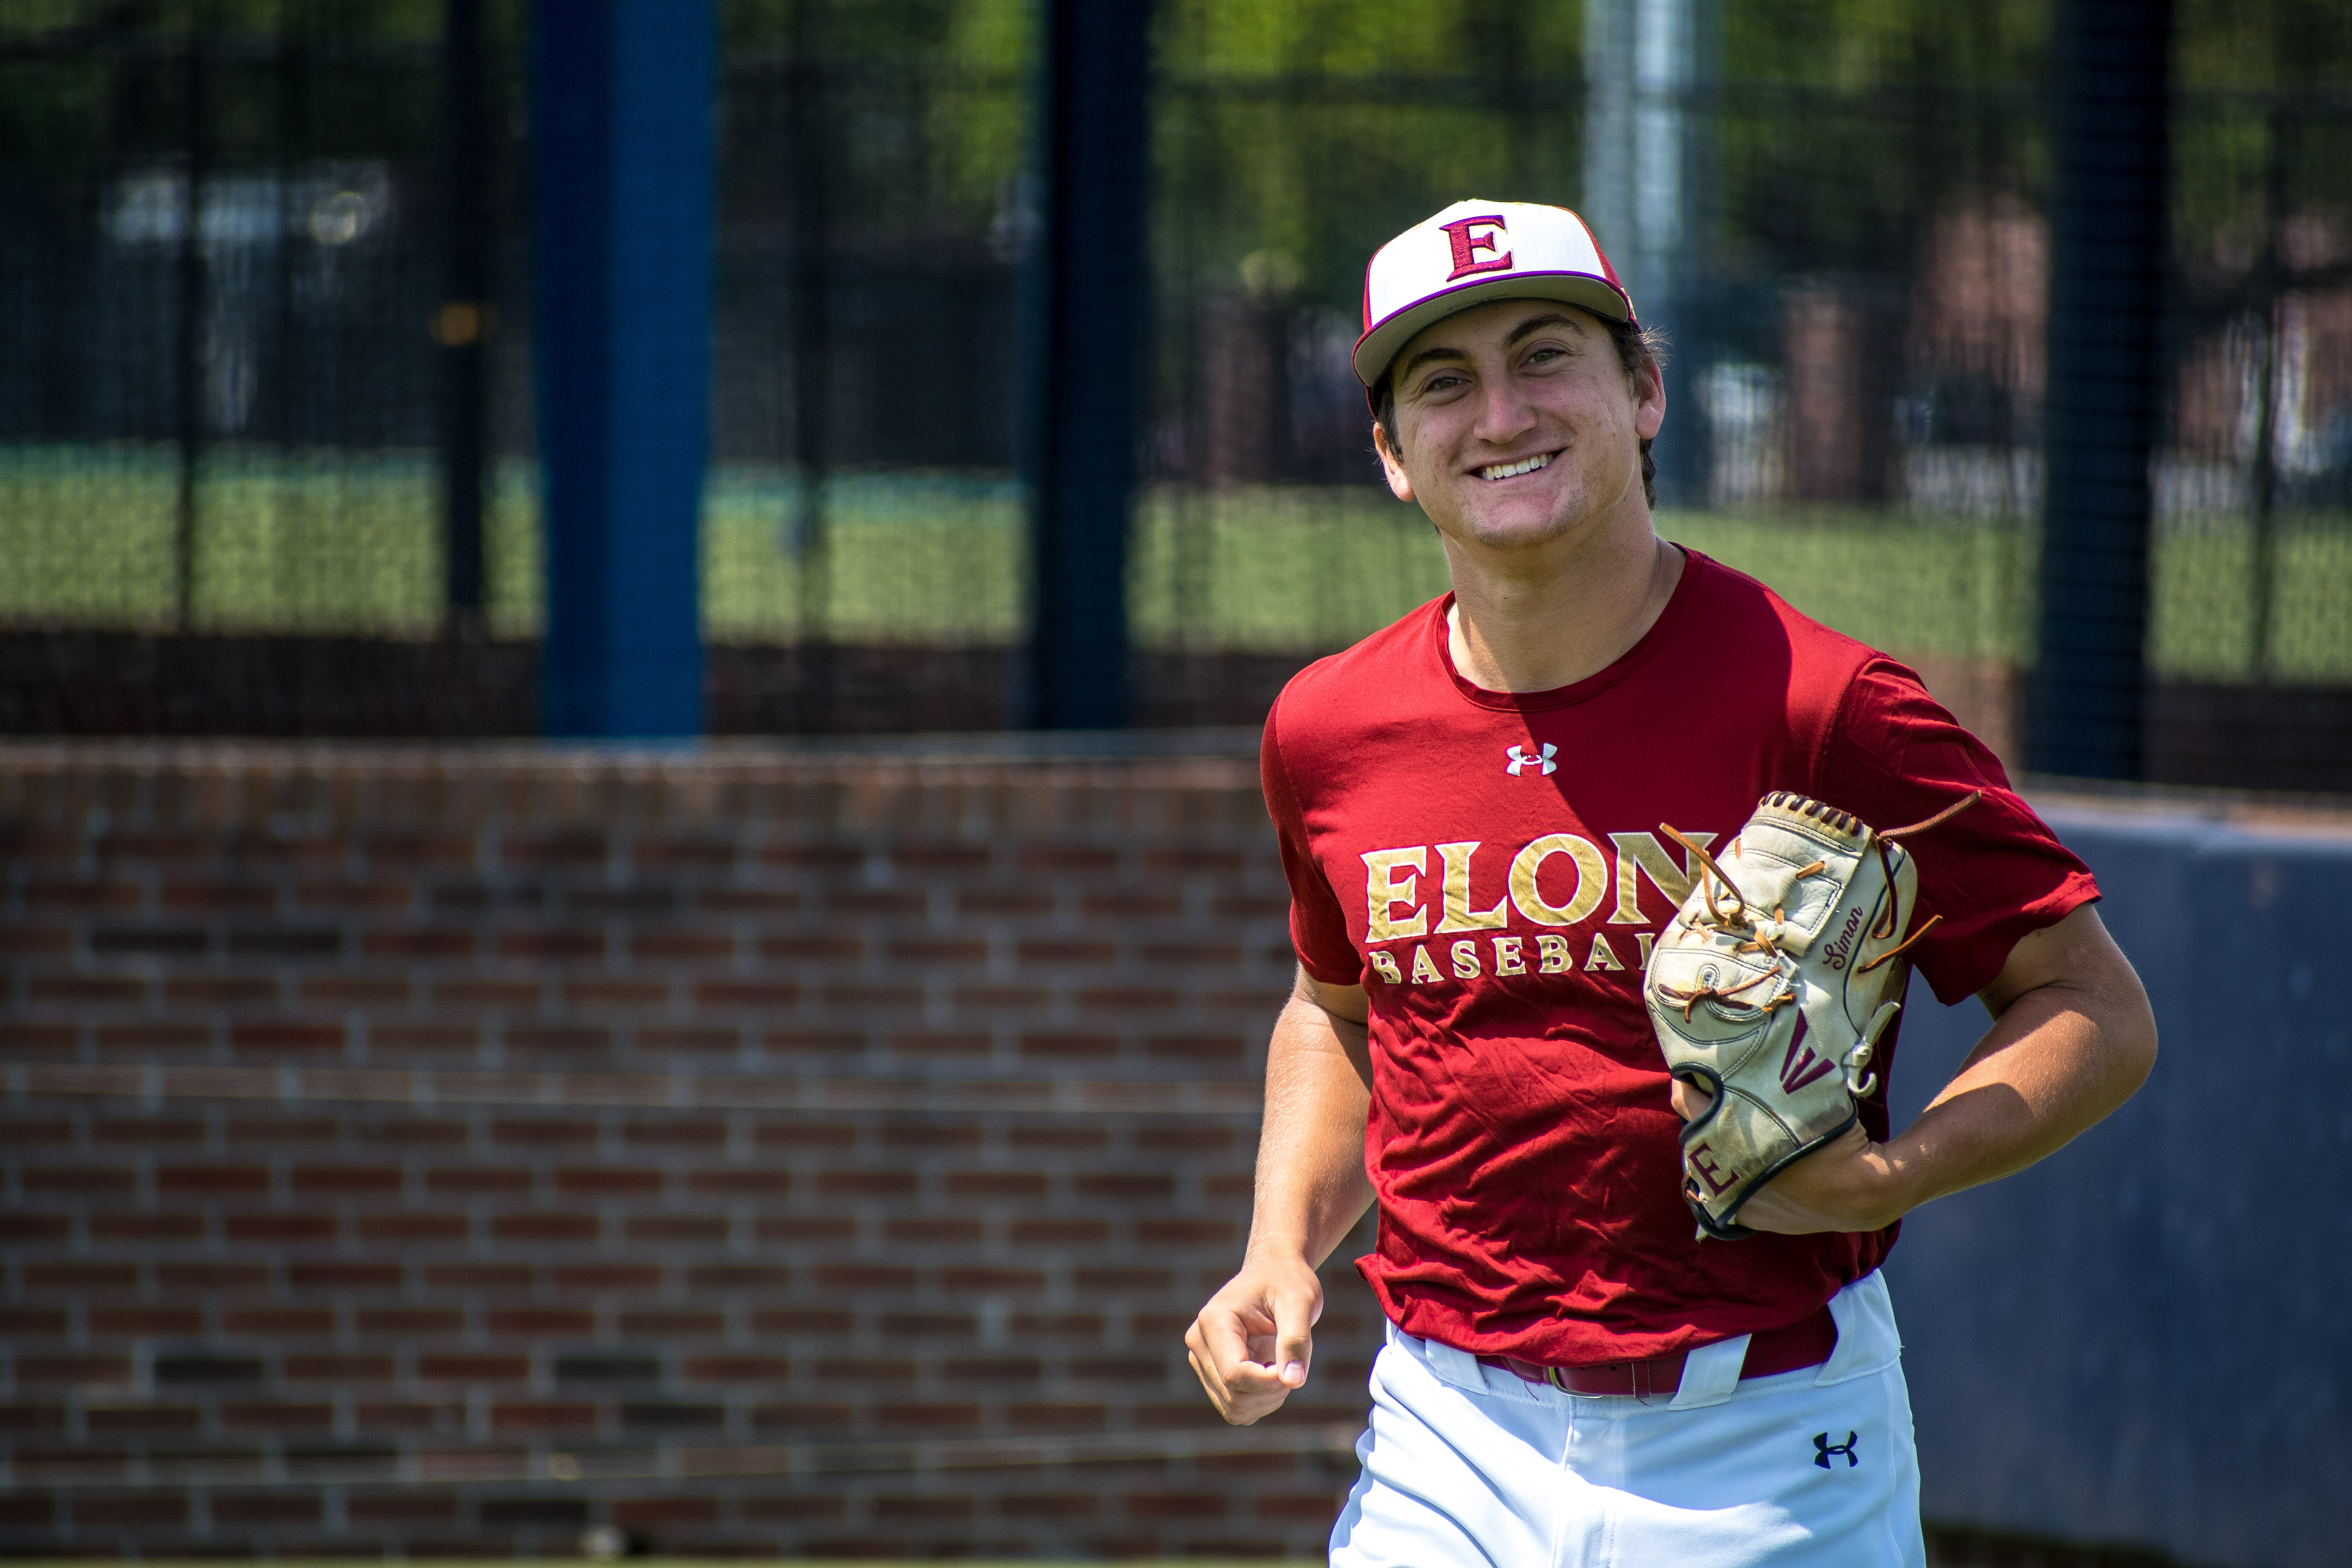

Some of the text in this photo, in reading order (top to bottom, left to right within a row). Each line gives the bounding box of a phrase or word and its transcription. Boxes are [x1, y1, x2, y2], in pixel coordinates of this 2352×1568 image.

[1438, 215, 1513, 283] E
[1360, 832, 1719, 943] ELON
[1822, 906, 1863, 970] Simon
[1688, 1142, 1740, 1197] E
